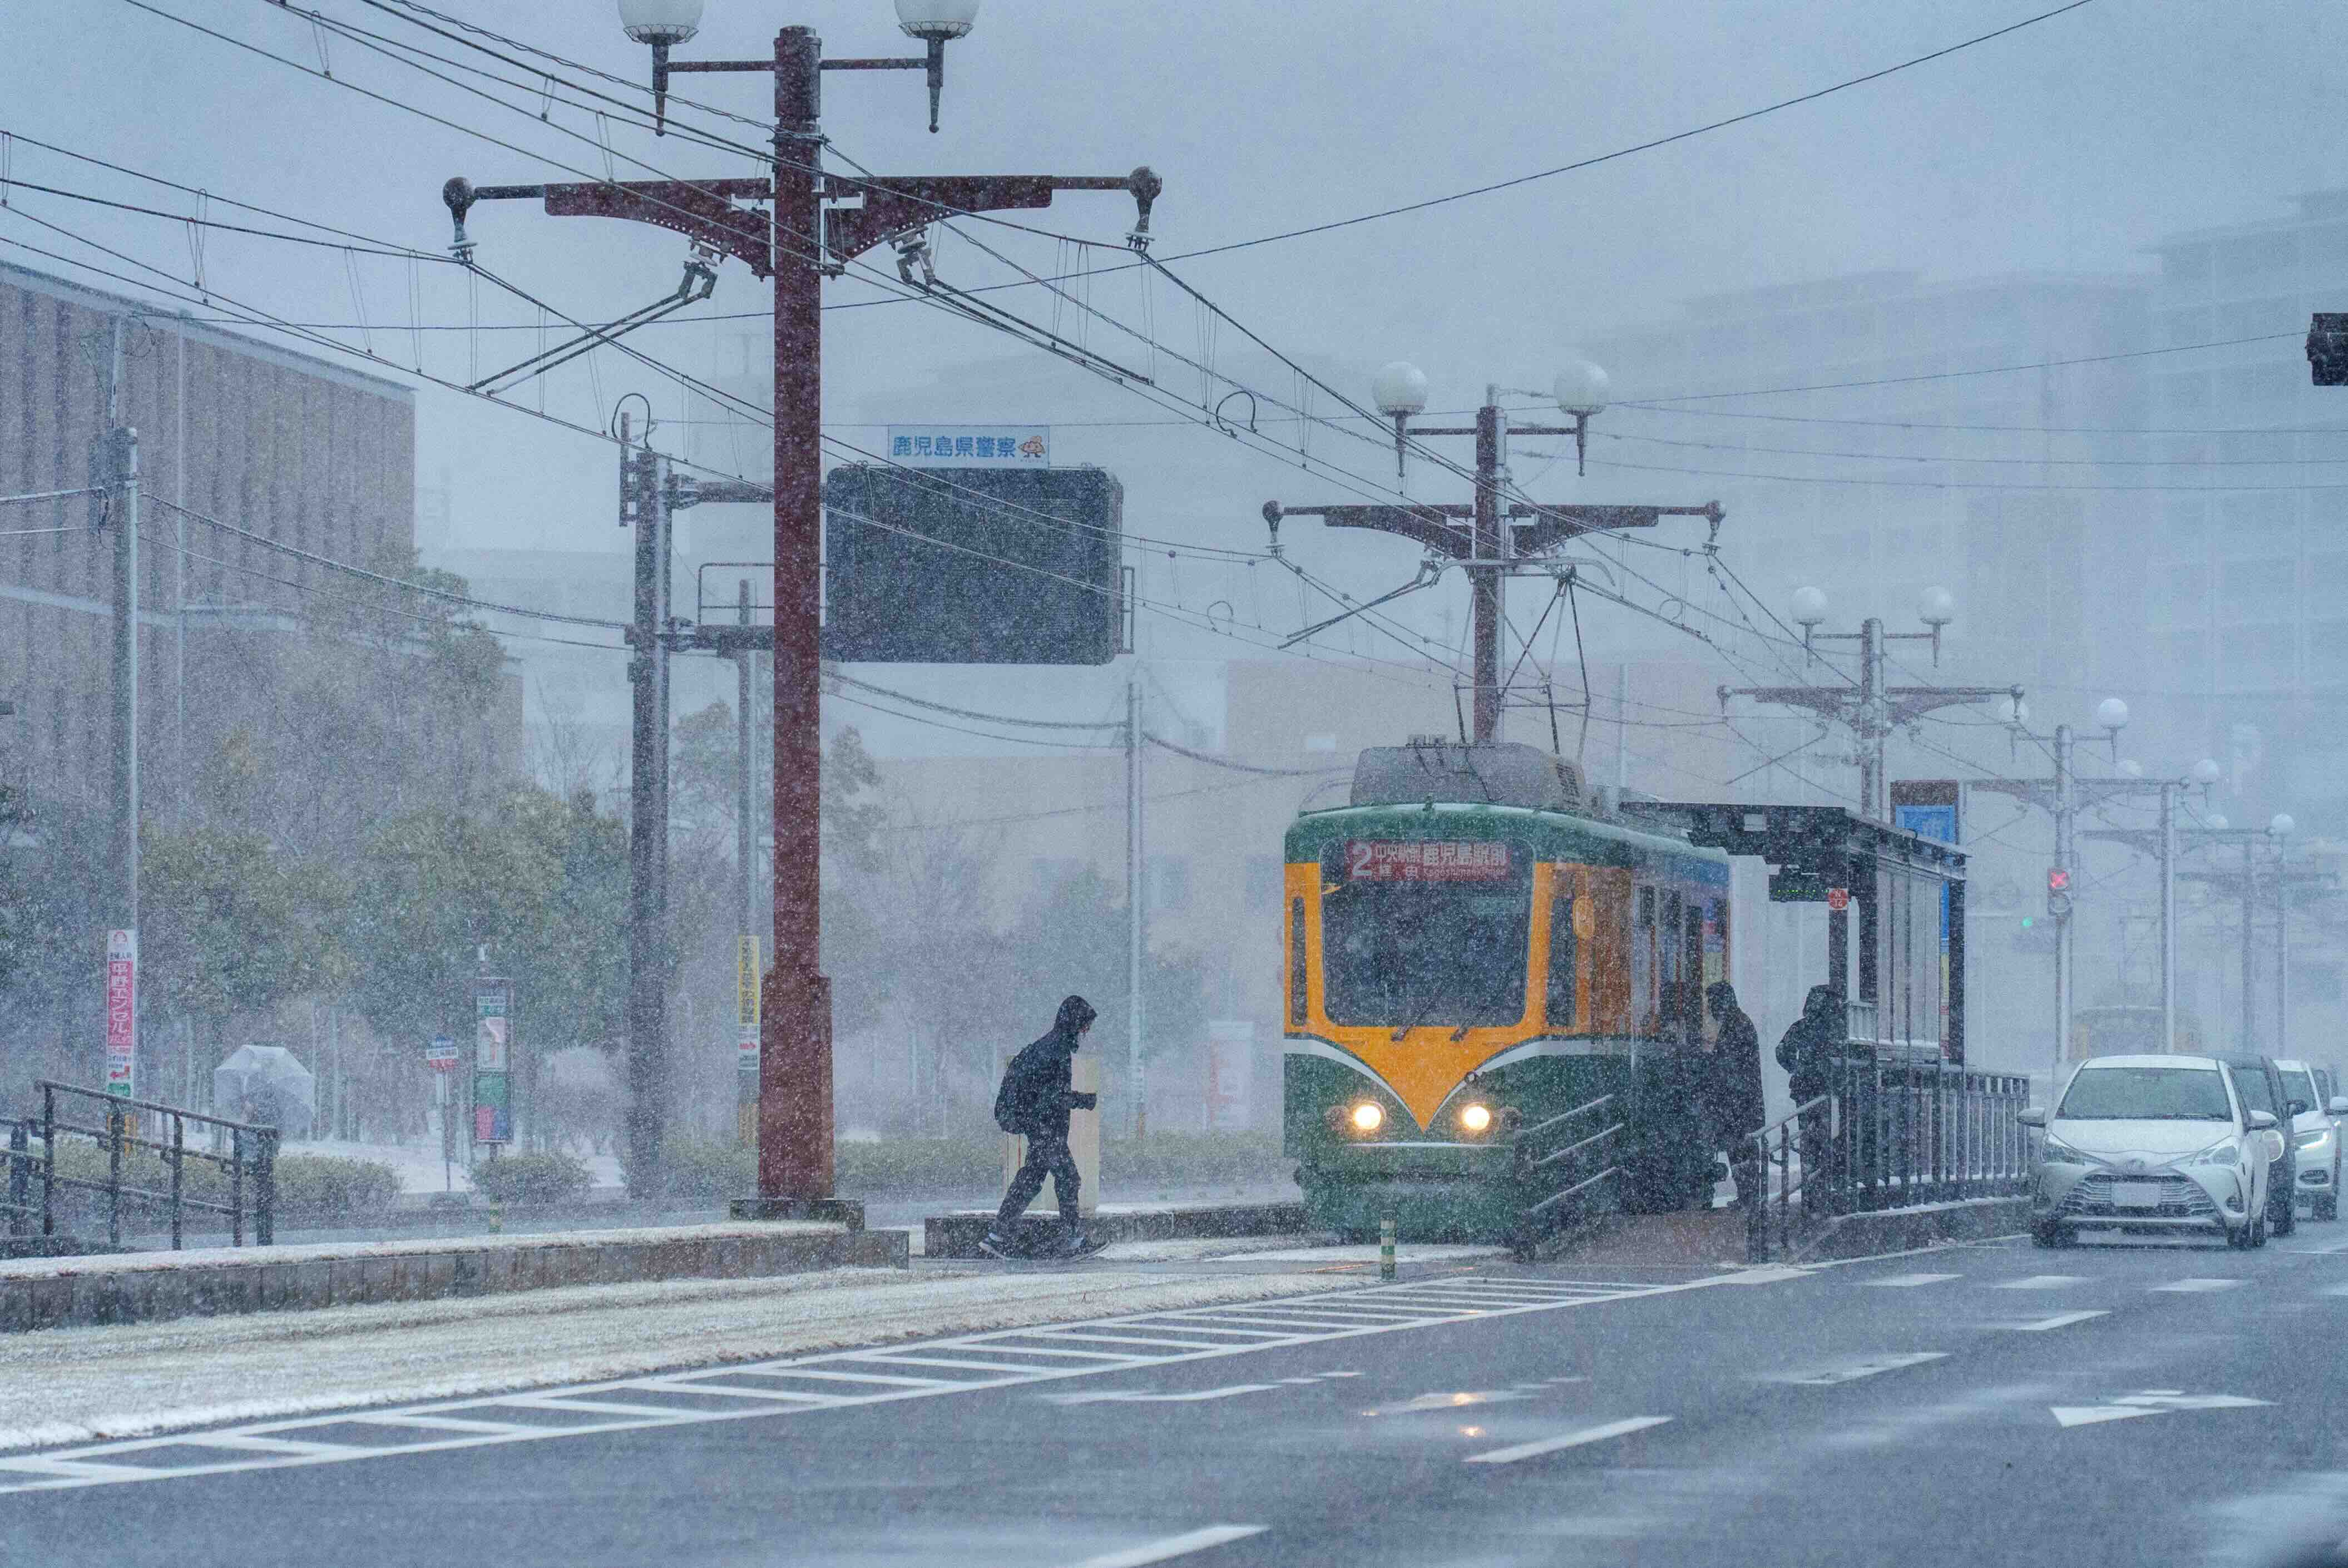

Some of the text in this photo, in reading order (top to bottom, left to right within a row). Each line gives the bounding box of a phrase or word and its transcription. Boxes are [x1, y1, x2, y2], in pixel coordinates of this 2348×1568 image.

[893, 435, 1016, 458] 鹿児島県警察
[1352, 842, 1372, 877] 2
[1423, 842, 1506, 865] 鹿児島駅前
